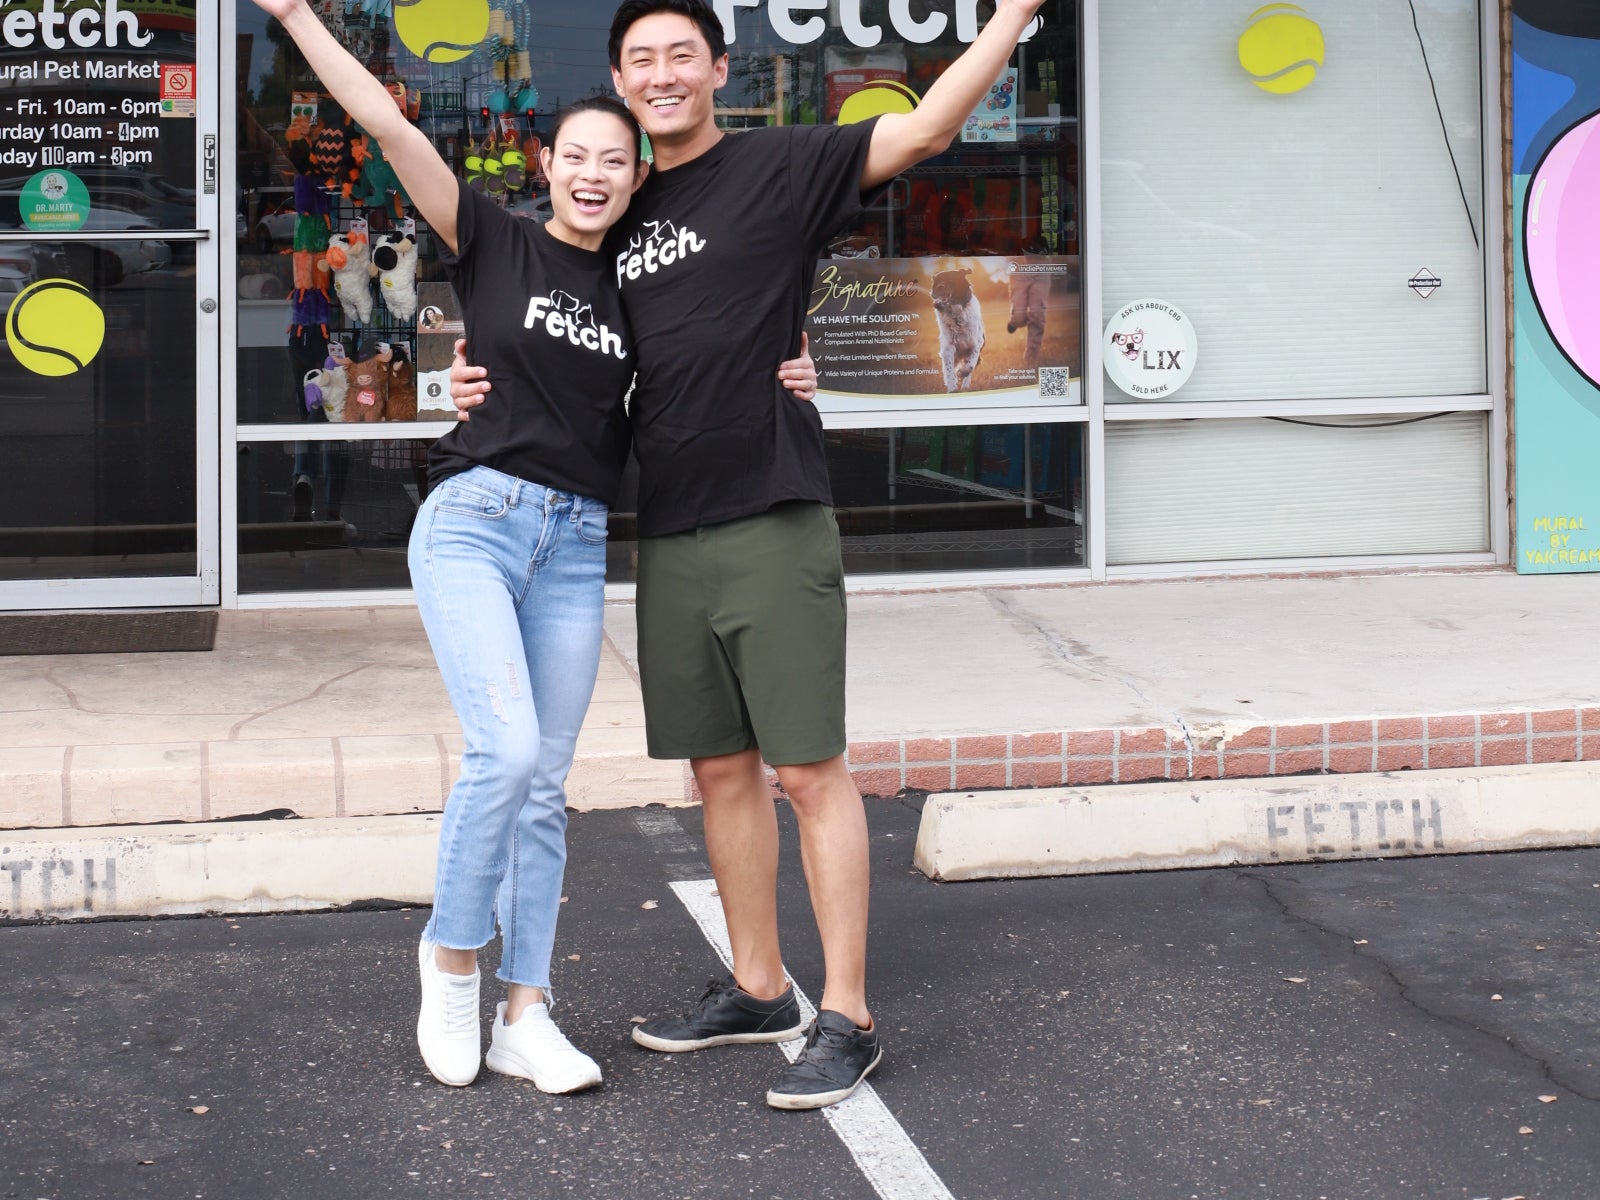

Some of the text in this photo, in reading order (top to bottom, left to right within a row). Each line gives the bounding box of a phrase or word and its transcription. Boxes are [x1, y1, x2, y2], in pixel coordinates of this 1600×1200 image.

[44, 60, 80, 80] Pet
[85, 60, 161, 80] Market
[17, 98, 48, 115] Fri.
[53, 98, 105, 115] 10am
[121, 98, 162, 118] 6pm
[0, 123, 45, 144] rday
[50, 123, 102, 140] 10am
[118, 122, 159, 142] 4pm
[0, 147, 38, 168] day
[42, 146, 95, 166] 10am
[111, 146, 152, 167] 3pm
[204, 138, 215, 181] PULL
[35, 203, 73, 213] DR. MARTY
[616, 226, 707, 290] Fetch
[812, 315, 827, 325] WE
[828, 314, 850, 324] HAVE
[851, 314, 868, 324] THE
[869, 313, 911, 323] SOLUTION
[1120, 302, 1182, 322] ASK US ABOUT CBD
[524, 296, 628, 360] Fetch
[824, 338, 855, 346] Companion
[851, 353, 871, 361] Limited
[871, 353, 897, 362] Ingredient
[1142, 350, 1182, 370] LIX
[839, 369, 857, 378] Variety
[864, 369, 883, 378] Unique
[883, 368, 905, 376] Proteins
[1131, 383, 1169, 394] SOLD HERE
[1533, 515, 1584, 532] MURAL
[1549, 533, 1571, 548] BY
[1266, 798, 1445, 860] FETCH
